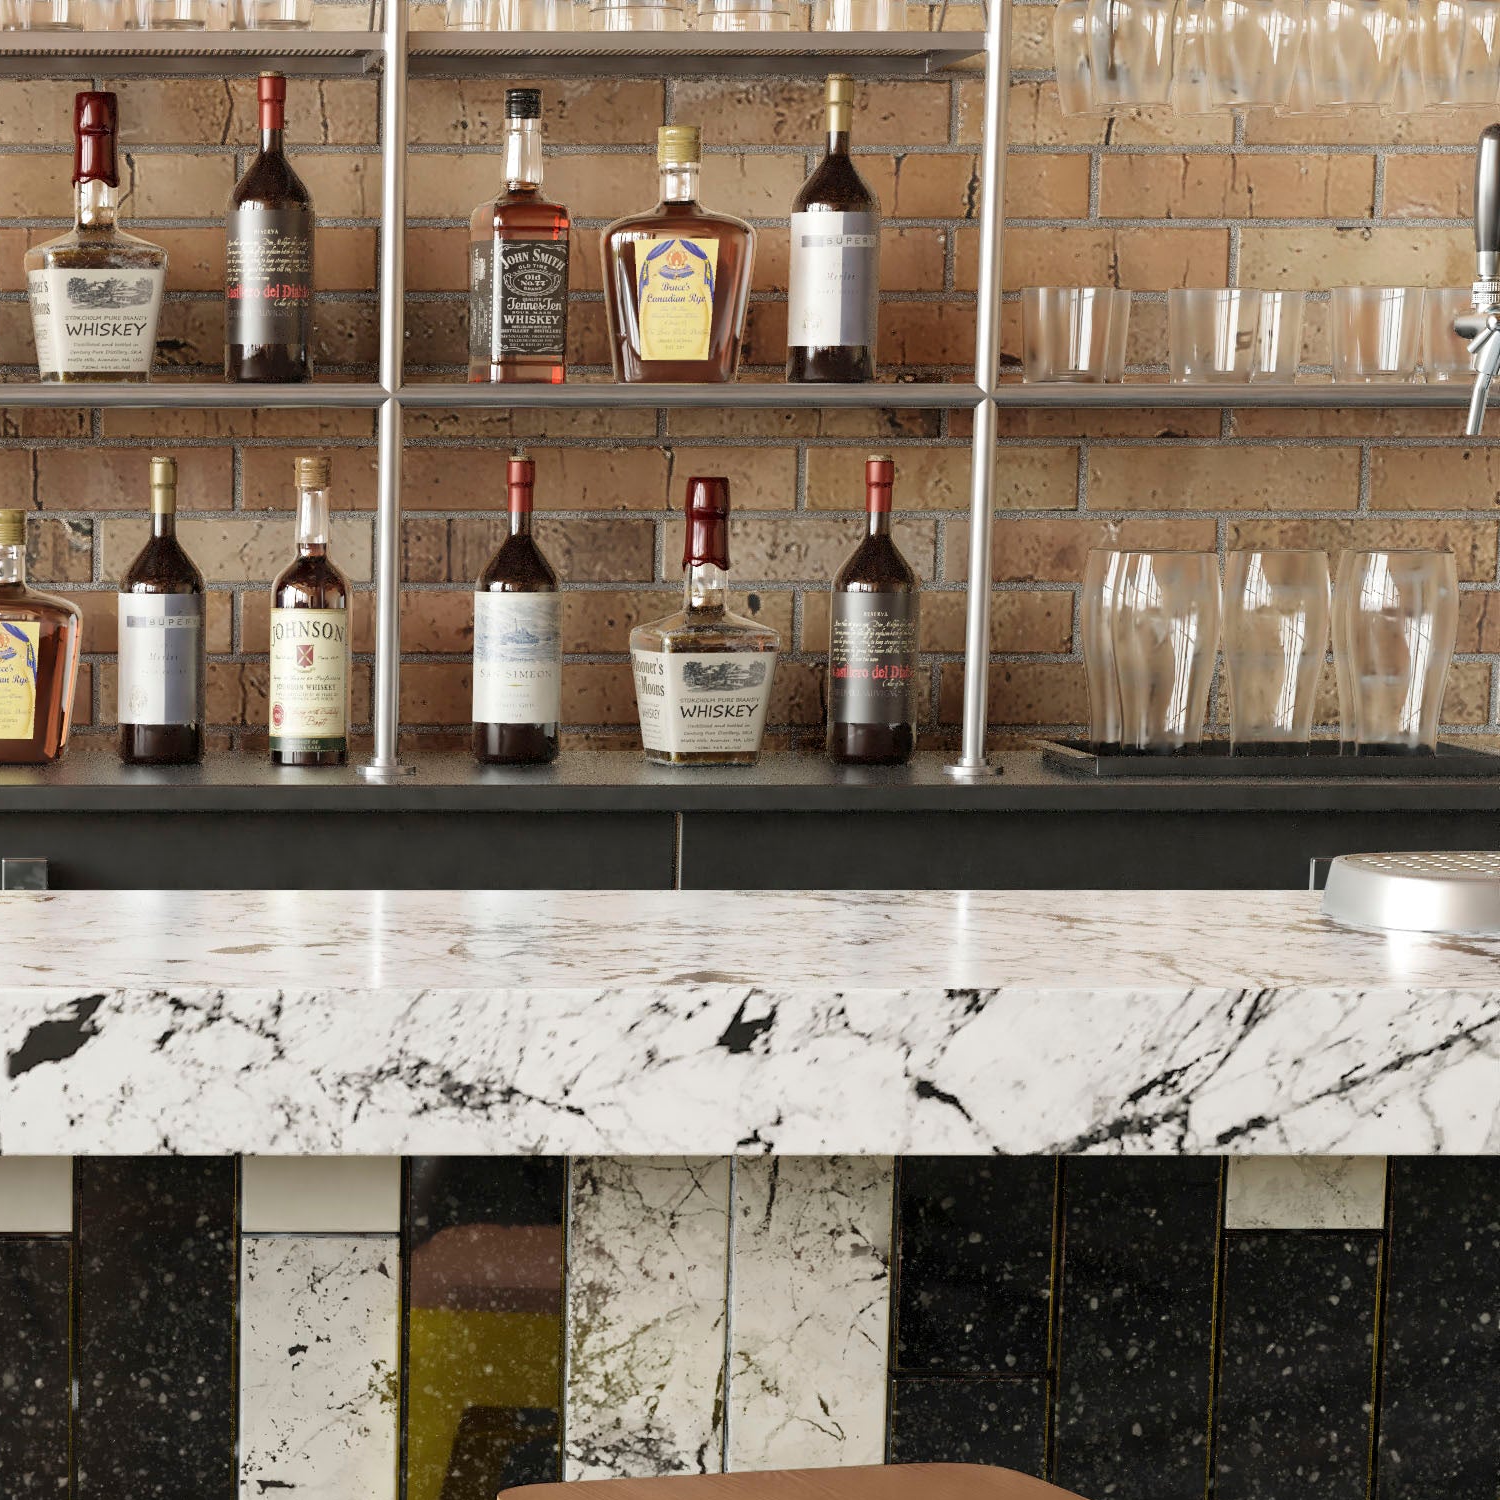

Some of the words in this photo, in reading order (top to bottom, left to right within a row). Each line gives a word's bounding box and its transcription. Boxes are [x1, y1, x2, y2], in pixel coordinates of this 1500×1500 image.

[501, 251, 529, 270] JOHN
[532, 249, 566, 271] SMITH
[504, 315, 560, 325] WHISKEY
[65, 322, 147, 337] WHISKEY
[272, 621, 345, 646] JOHNSON
[680, 704, 759, 718] WHISKEY
